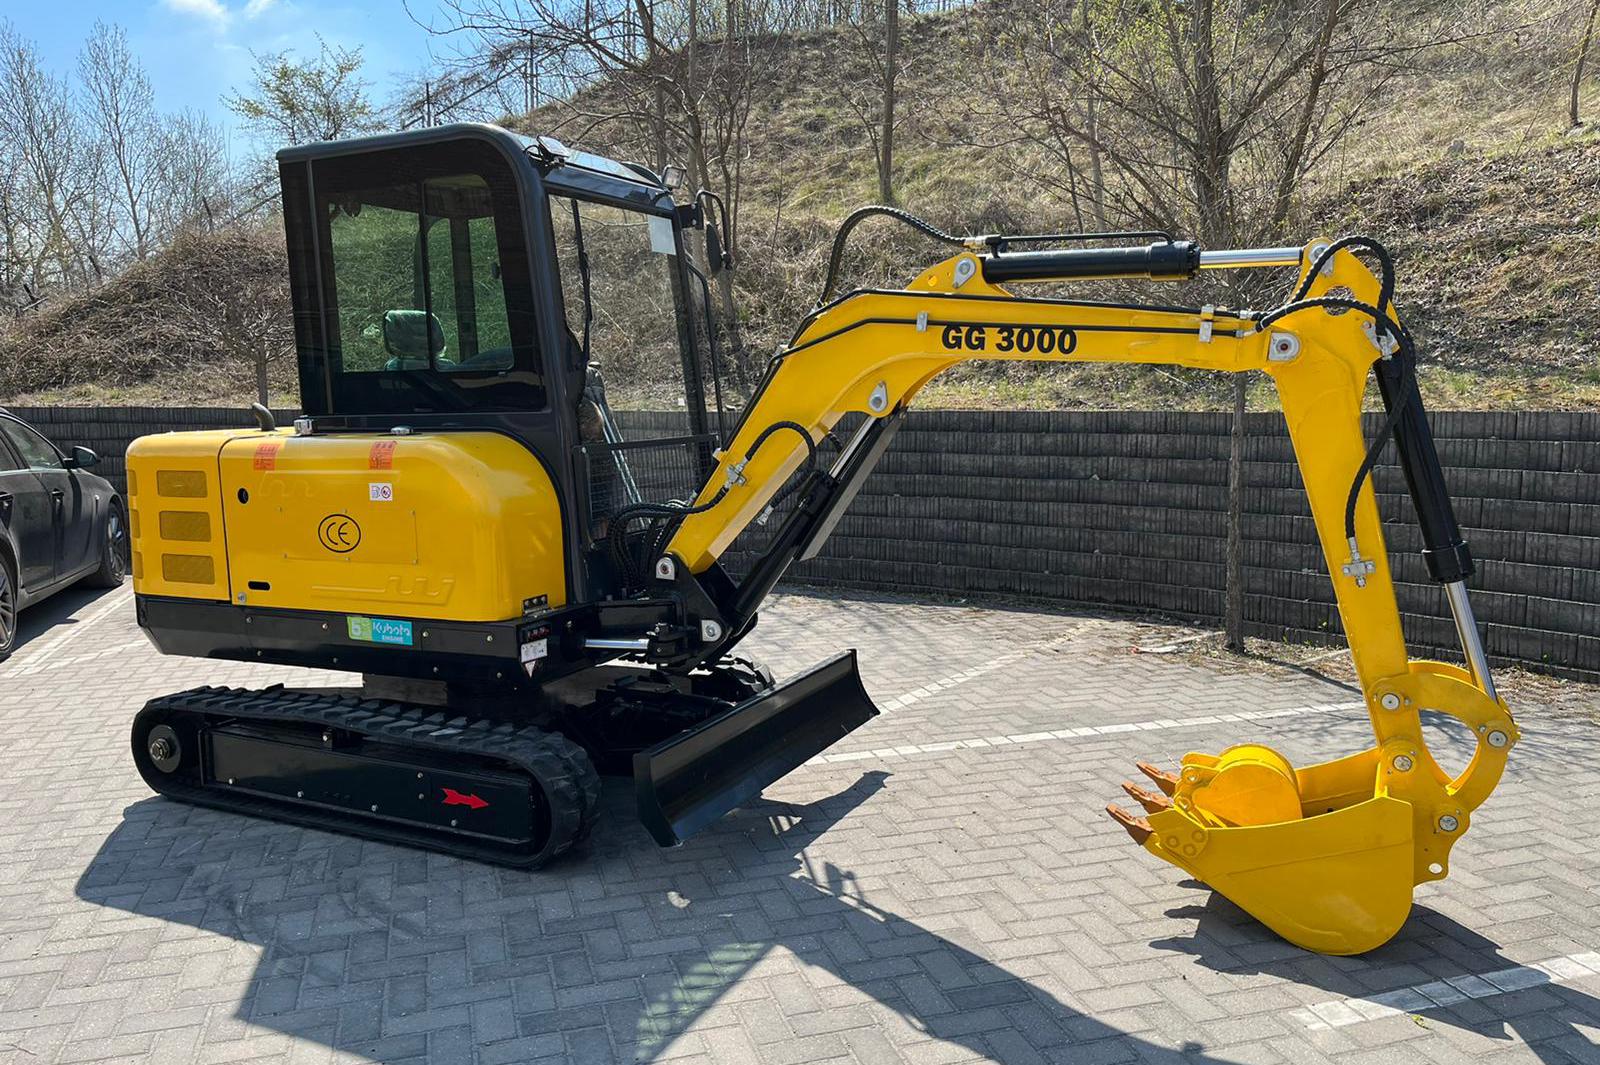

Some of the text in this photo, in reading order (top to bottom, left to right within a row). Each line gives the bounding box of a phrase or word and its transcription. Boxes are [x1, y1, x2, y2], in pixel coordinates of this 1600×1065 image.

[941, 324, 1077, 355] GG 3000
[326, 521, 350, 546] CE
[372, 621, 411, 637] Kubota
